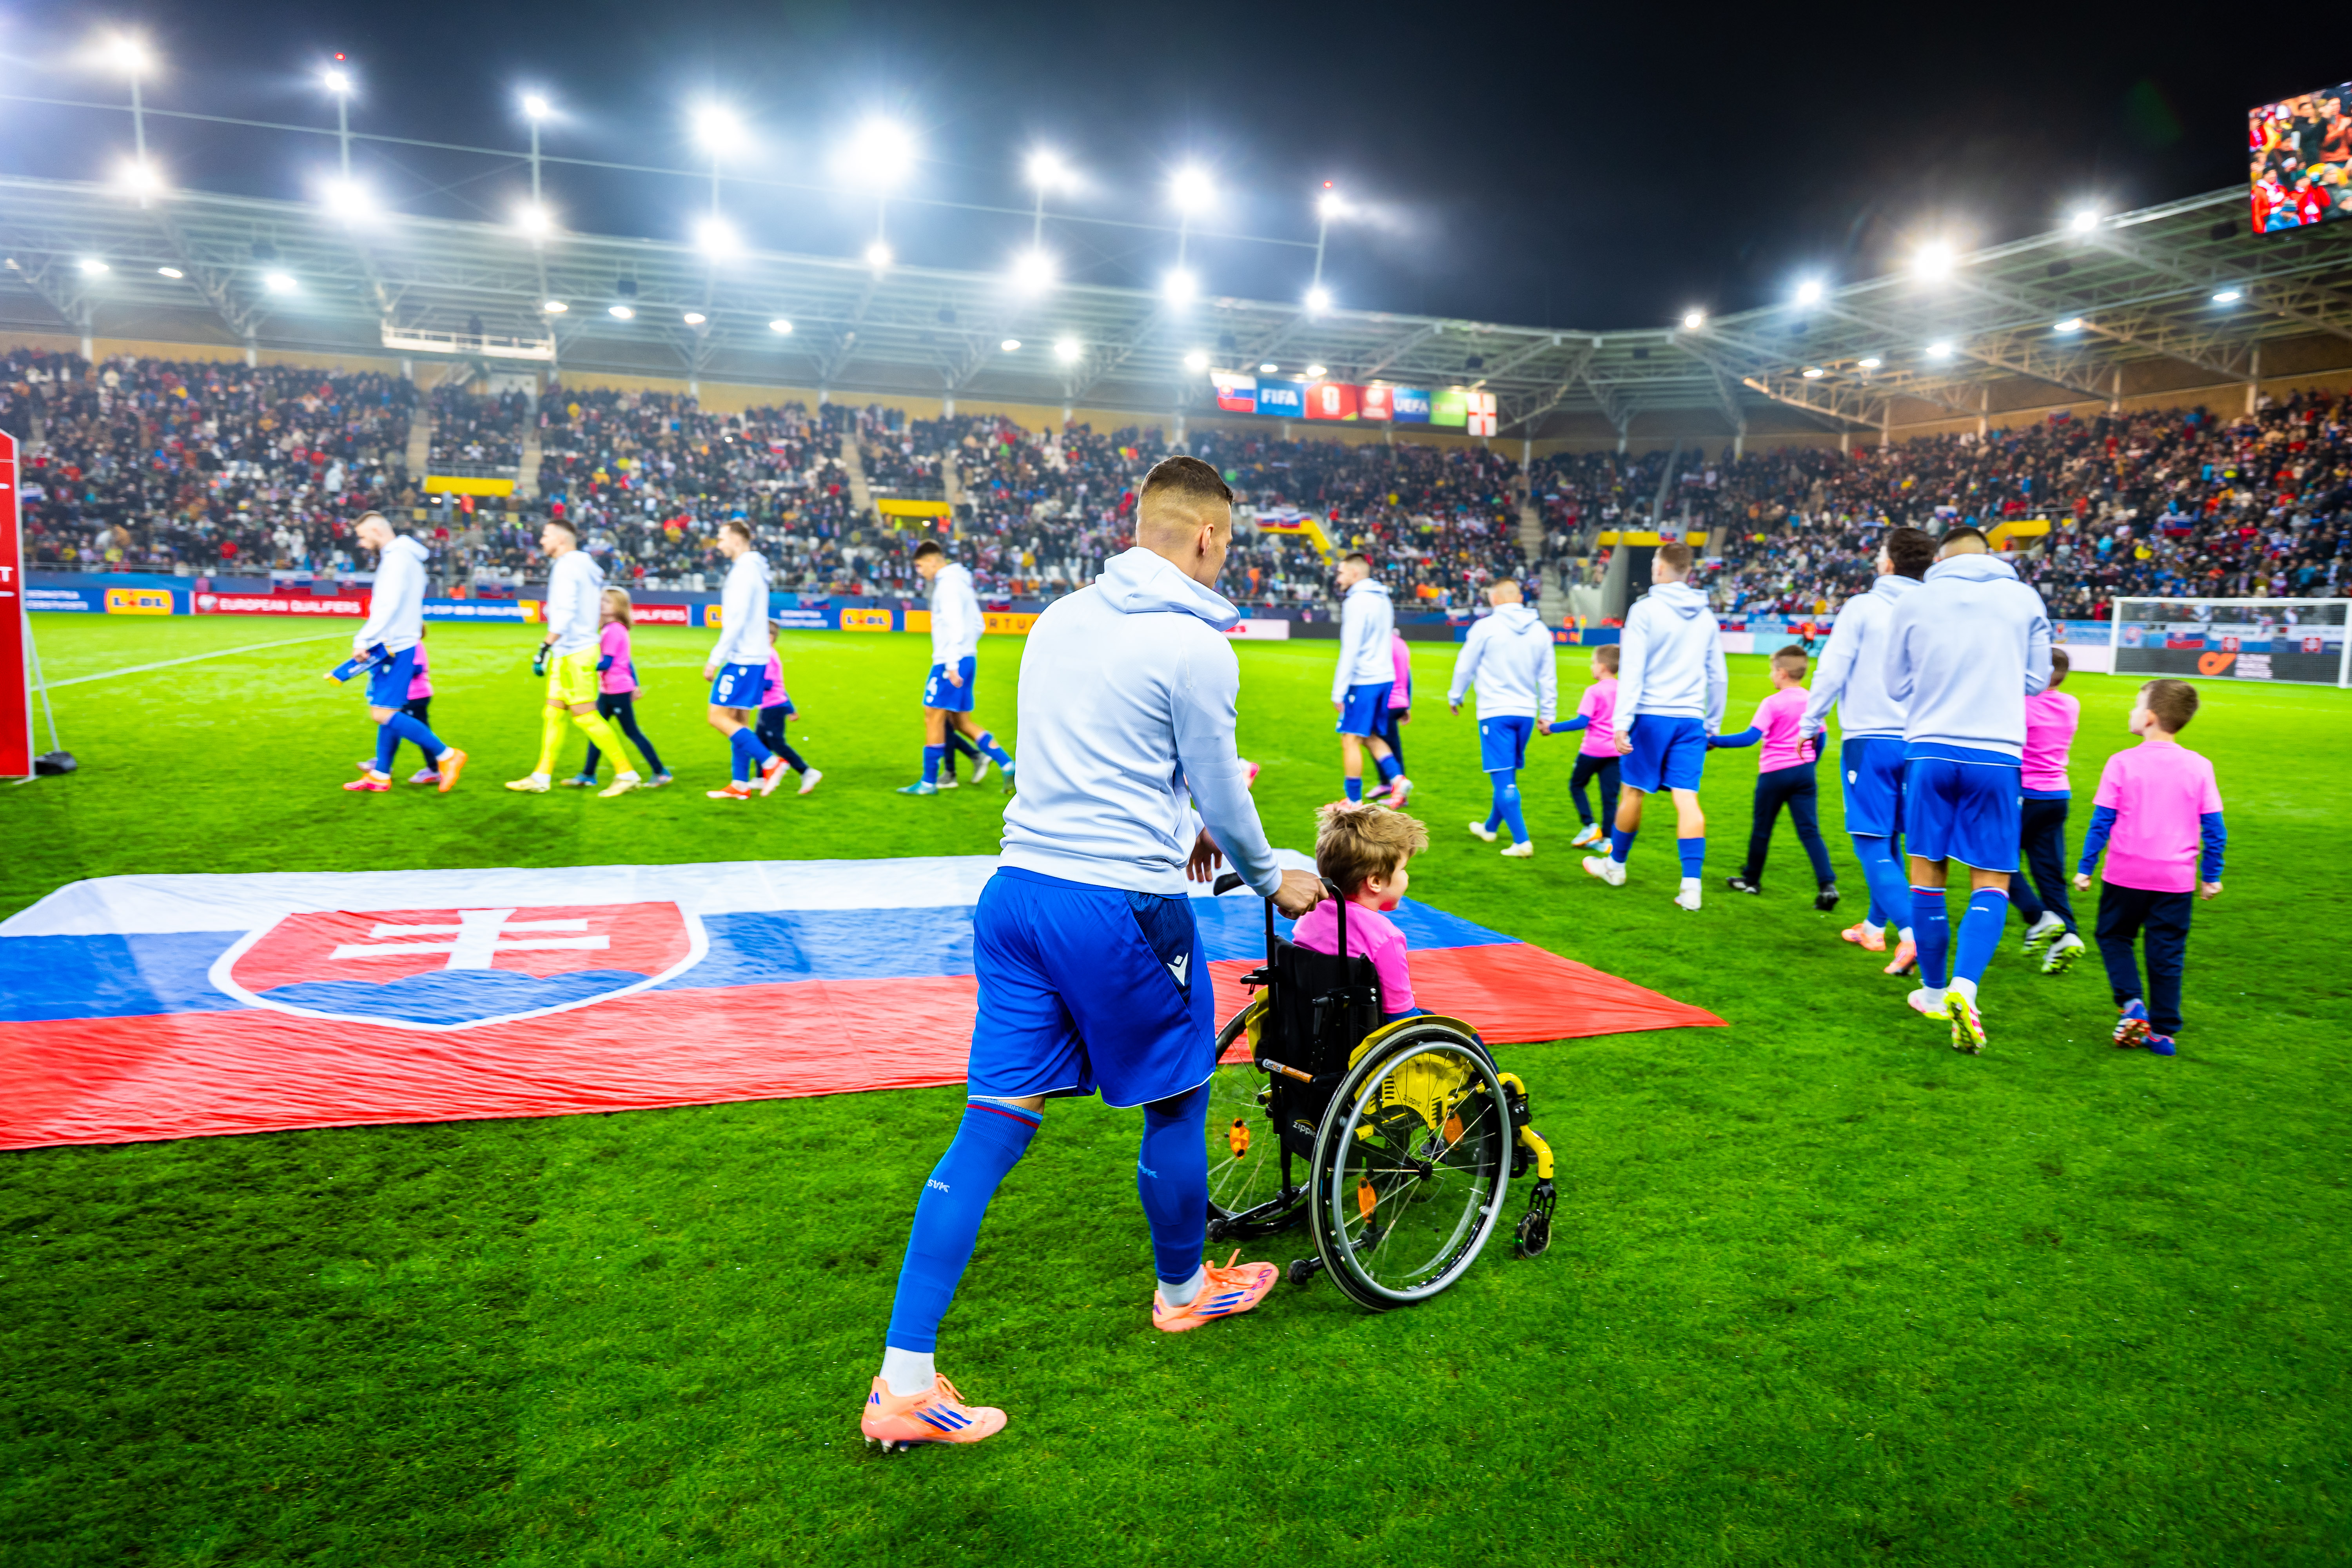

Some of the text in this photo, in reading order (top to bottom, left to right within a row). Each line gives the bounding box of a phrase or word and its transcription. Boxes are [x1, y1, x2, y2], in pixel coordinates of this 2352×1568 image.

[1261, 388, 1298, 406] FIFA
[1394, 398, 1428, 412] UEFA
[113, 591, 166, 607] LIDL
[219, 598, 289, 612] EUROPEAN
[847, 610, 886, 624] LIDL
[718, 674, 735, 695] 6
[927, 1179, 950, 1193] SVK
